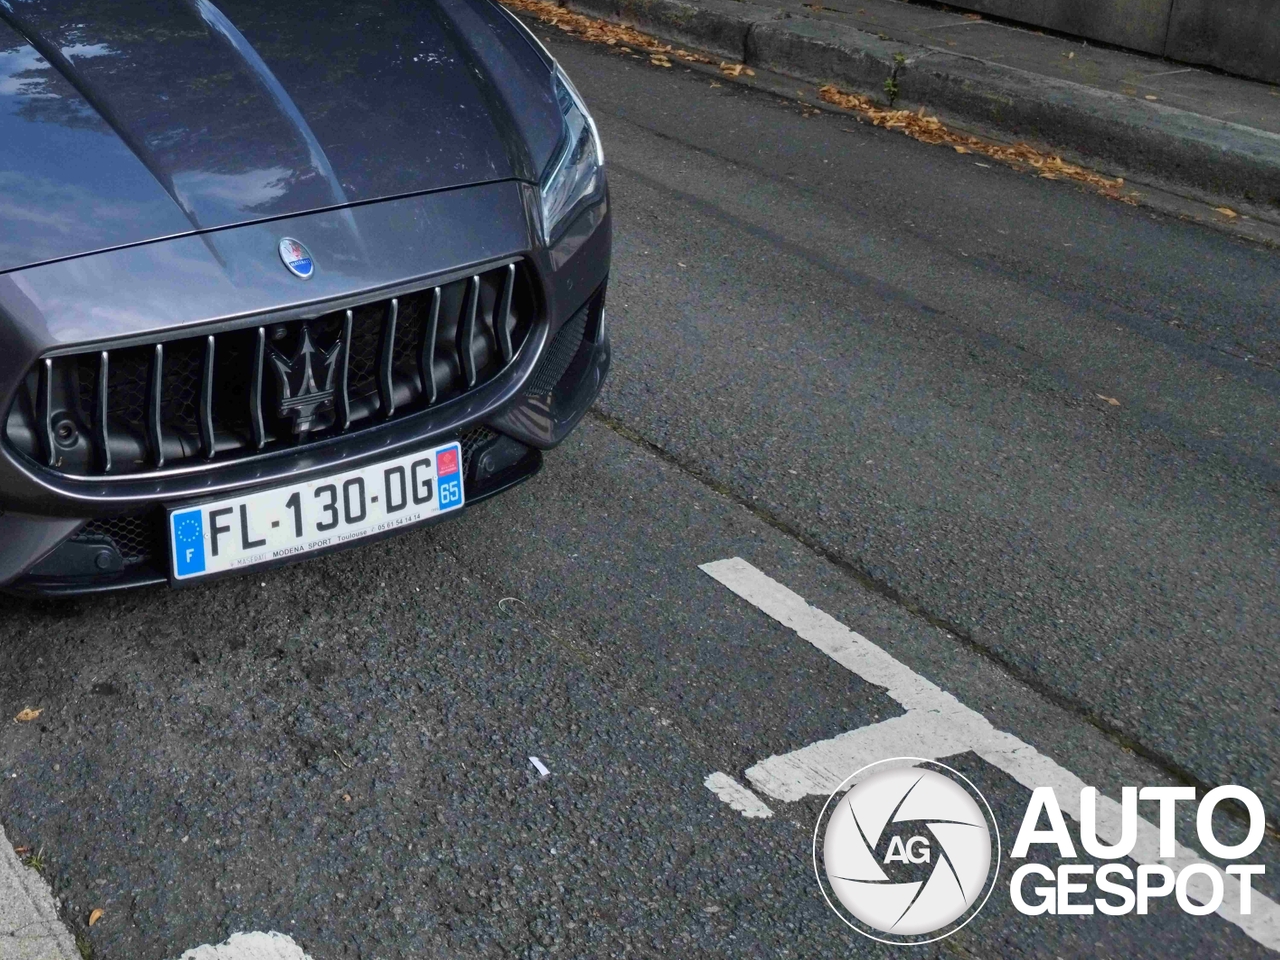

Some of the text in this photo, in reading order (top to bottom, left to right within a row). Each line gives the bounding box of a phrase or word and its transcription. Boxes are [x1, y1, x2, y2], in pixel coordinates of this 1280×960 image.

[440, 480, 459, 504] 65
[209, 457, 434, 557] FL-130-DG
[186, 548, 195, 564] F
[272, 545, 305, 558] MODENA
[308, 538, 332, 550] SPORT
[337, 529, 367, 542] Toulouse
